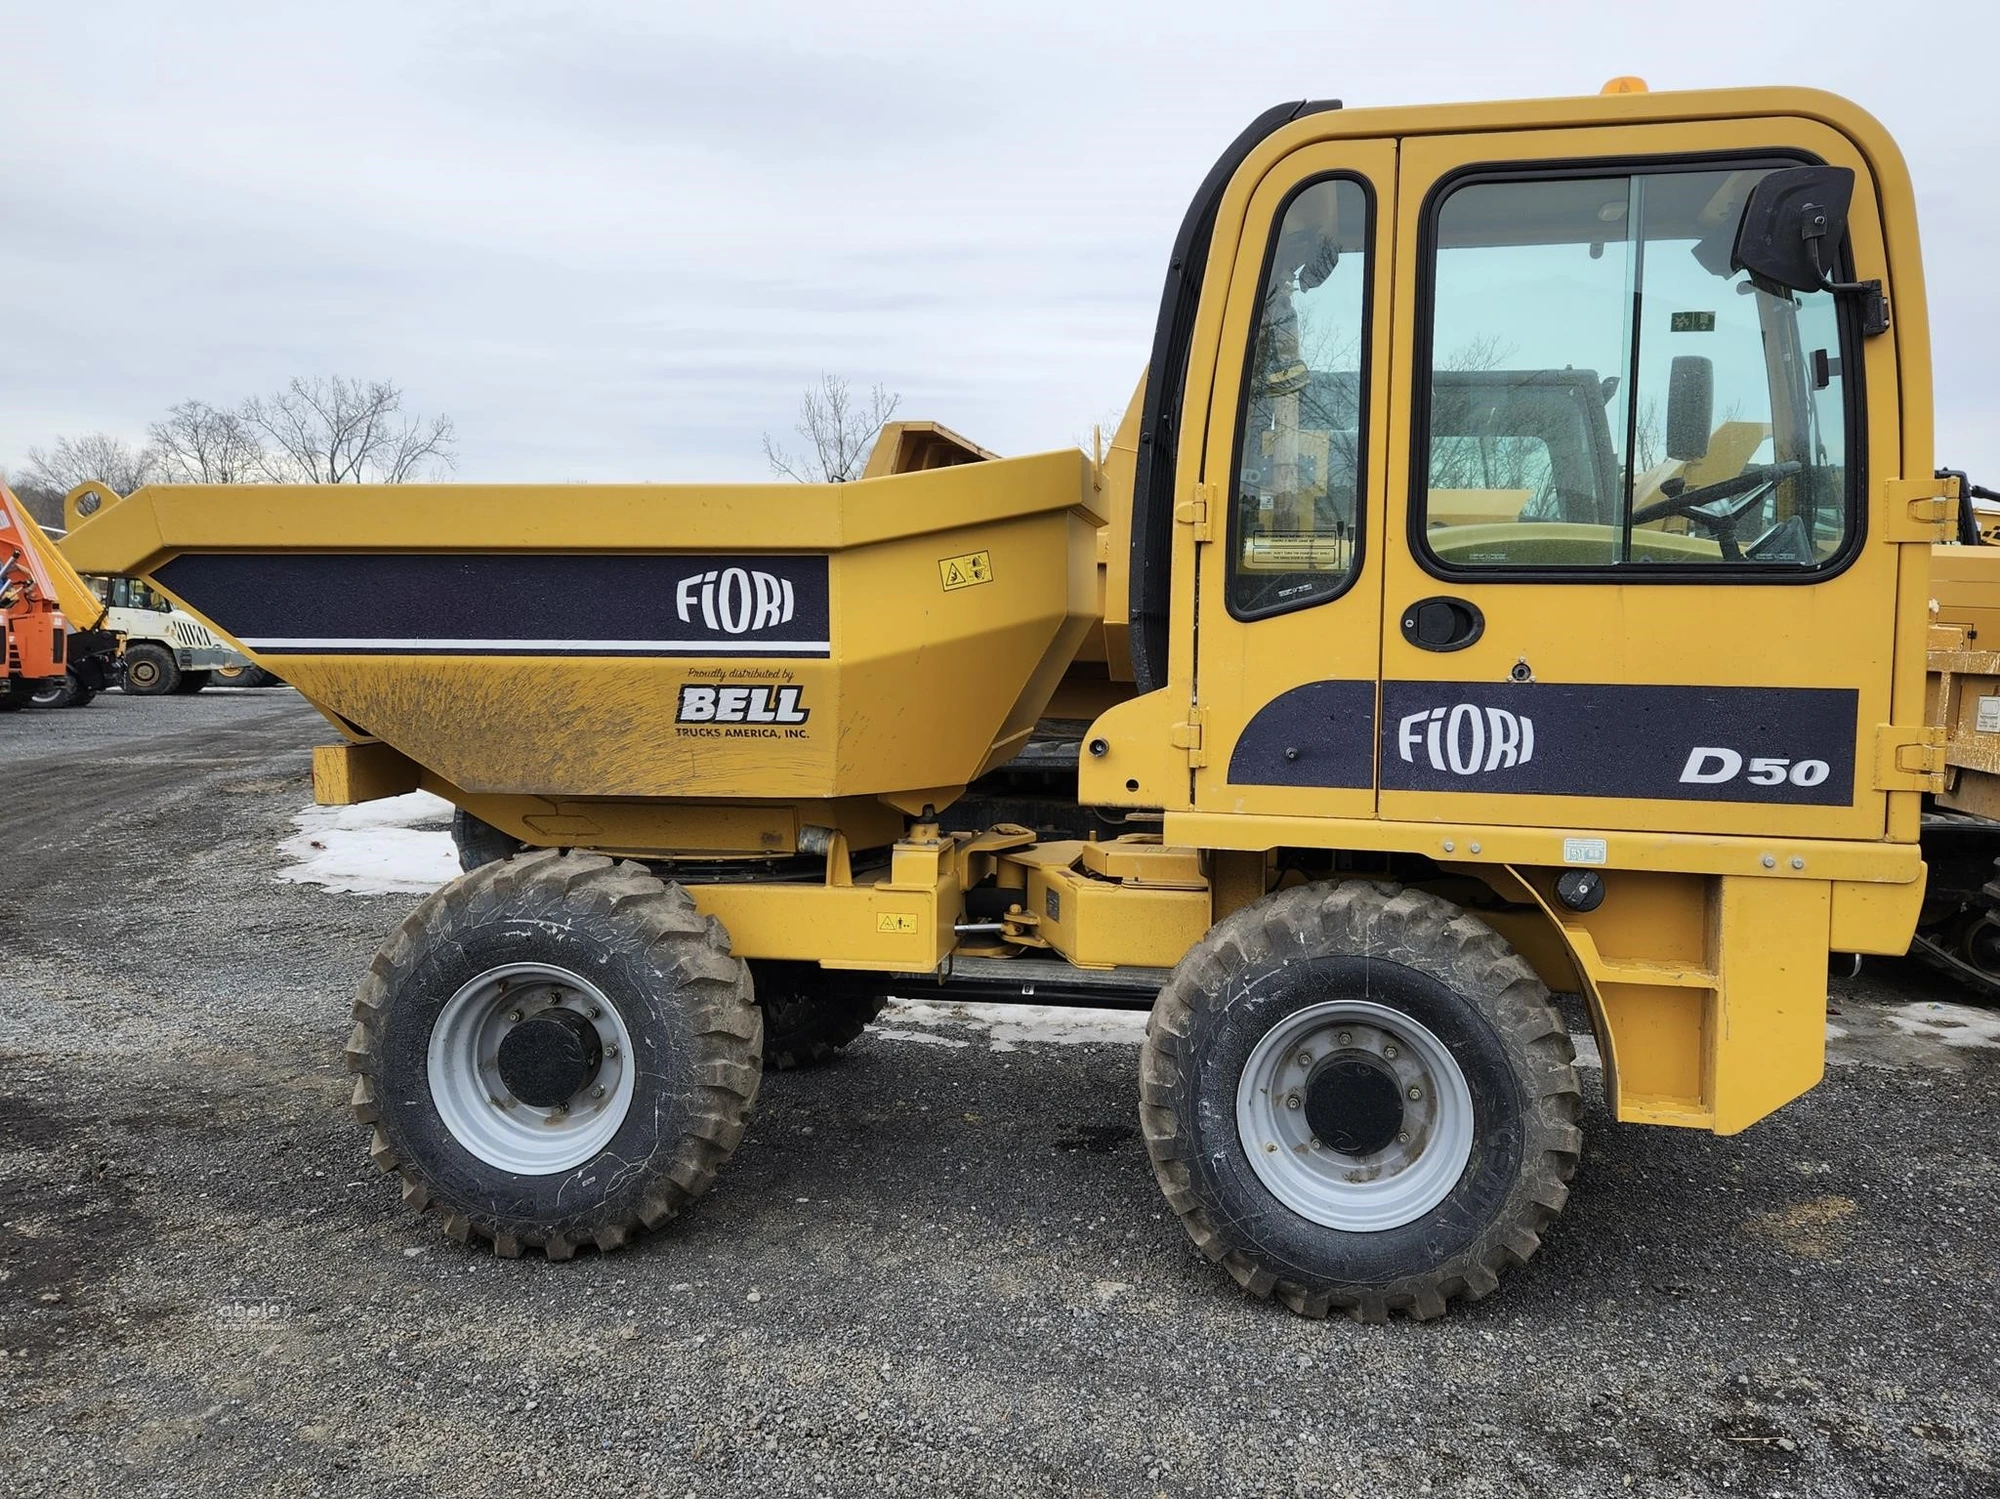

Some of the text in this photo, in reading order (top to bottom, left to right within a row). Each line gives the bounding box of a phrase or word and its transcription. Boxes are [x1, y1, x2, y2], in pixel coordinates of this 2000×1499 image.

[687, 668, 794, 683] Proudly distributed by
[677, 686, 809, 723] BELL
[675, 728, 810, 740] TRUCKS AMERICA, INC.
